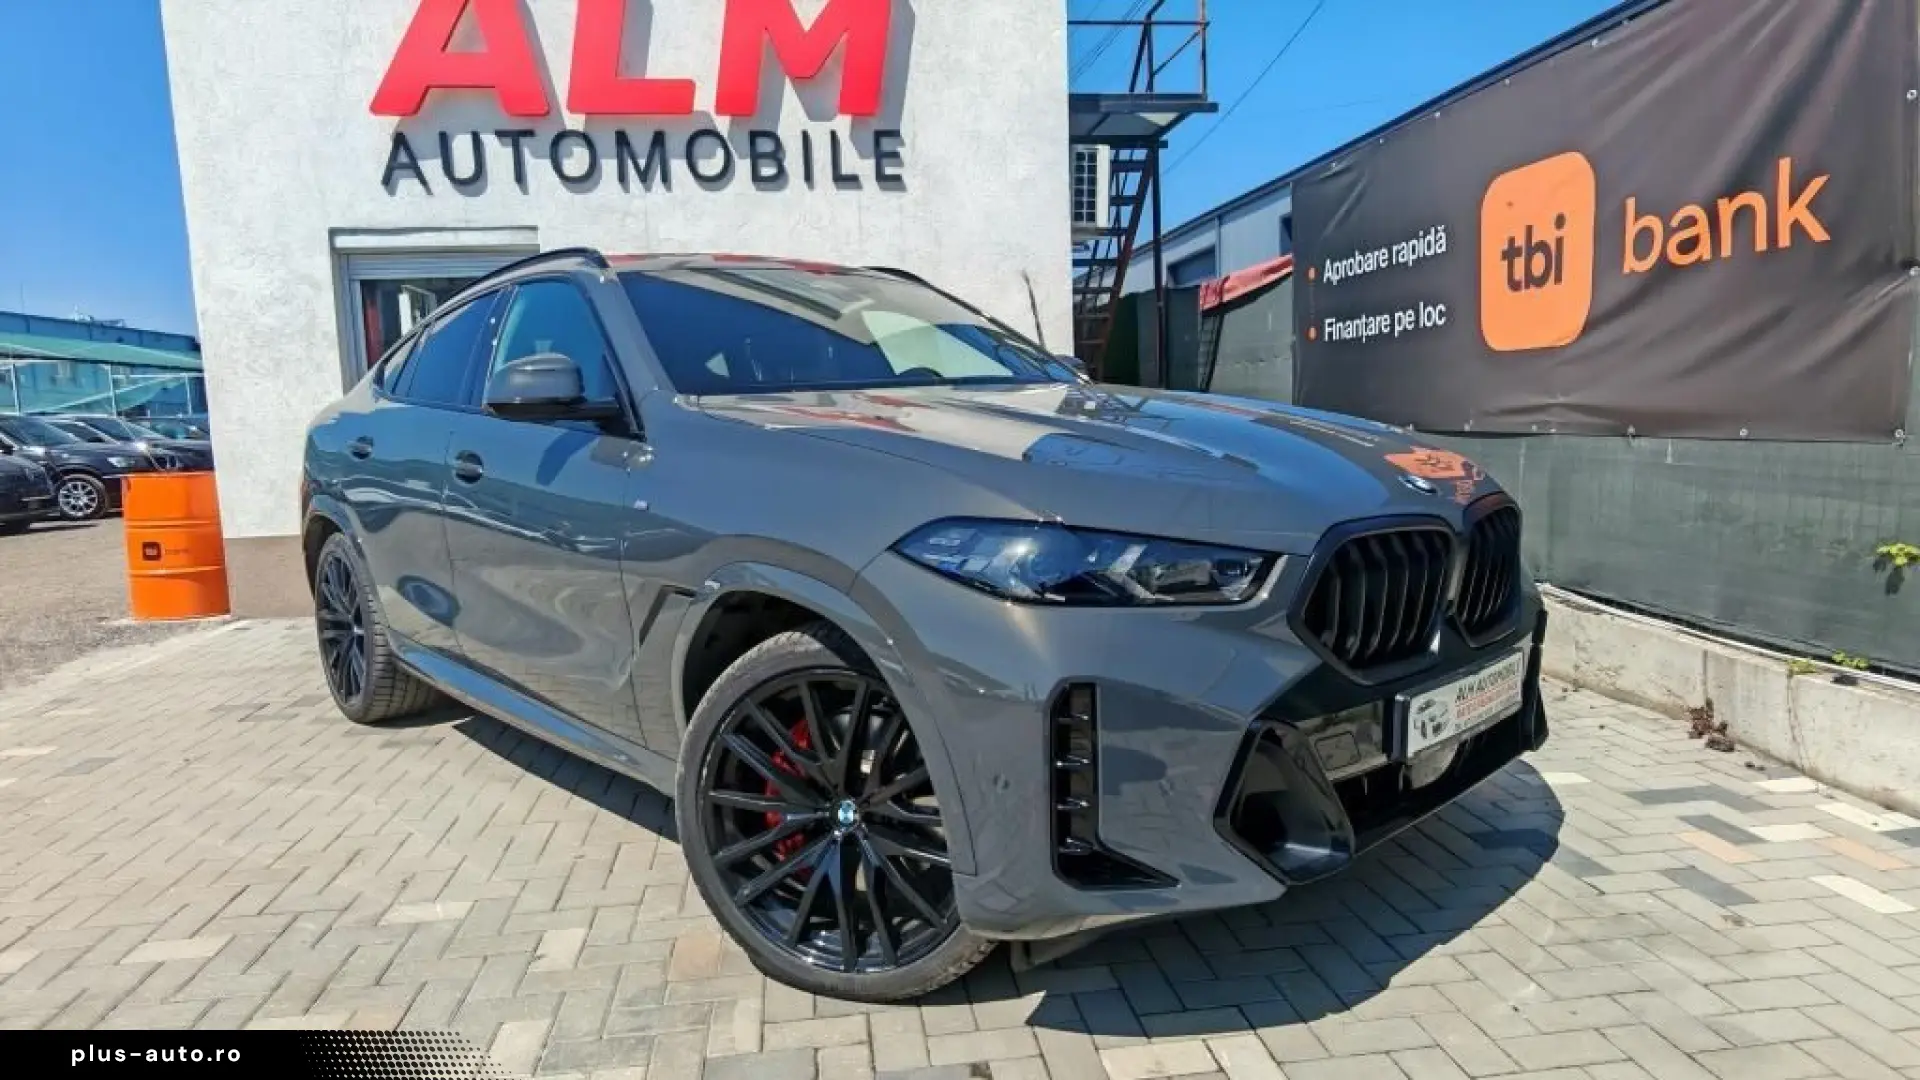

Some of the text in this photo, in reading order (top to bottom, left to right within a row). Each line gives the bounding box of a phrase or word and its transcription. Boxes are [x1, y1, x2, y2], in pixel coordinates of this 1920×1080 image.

[369, 0, 894, 116] ALM
[381, 128, 905, 192] AUTOMOBILE
[1323, 225, 1447, 286] Aprobare rapidă
[1500, 156, 1832, 293] tbi bank
[1394, 309, 1415, 338] pe
[1419, 301, 1447, 328] loc
